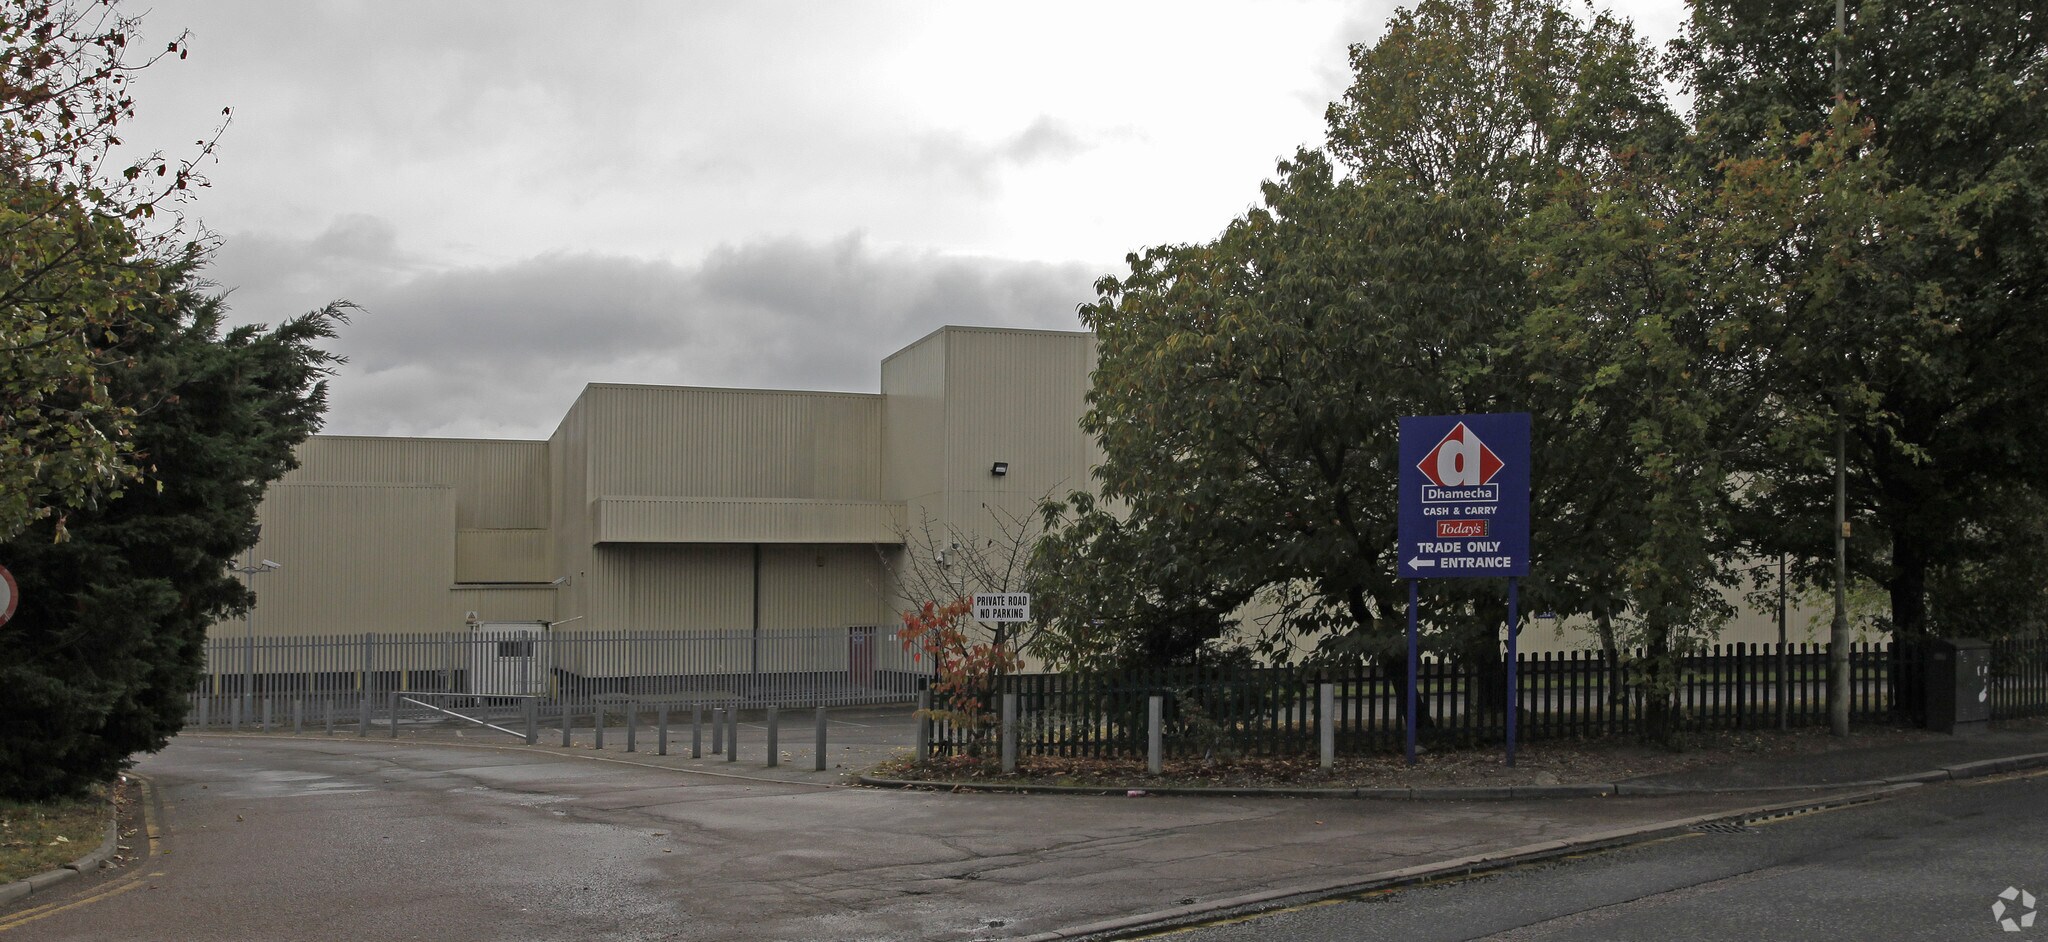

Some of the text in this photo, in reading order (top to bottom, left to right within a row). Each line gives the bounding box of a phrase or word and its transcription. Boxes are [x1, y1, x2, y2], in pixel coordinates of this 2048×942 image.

[1437, 425, 1480, 486] d
[1428, 488, 1492, 499] Dhamecha
[1423, 506, 1498, 516] CASH & CARRY
[1440, 522, 1481, 536] Today's
[1417, 541, 1501, 553] TRADE ONLY
[1440, 556, 1511, 568] ENTRANCE
[976, 596, 1027, 606] PRIVATE ROAD
[980, 608, 1023, 618] NO PARKING
